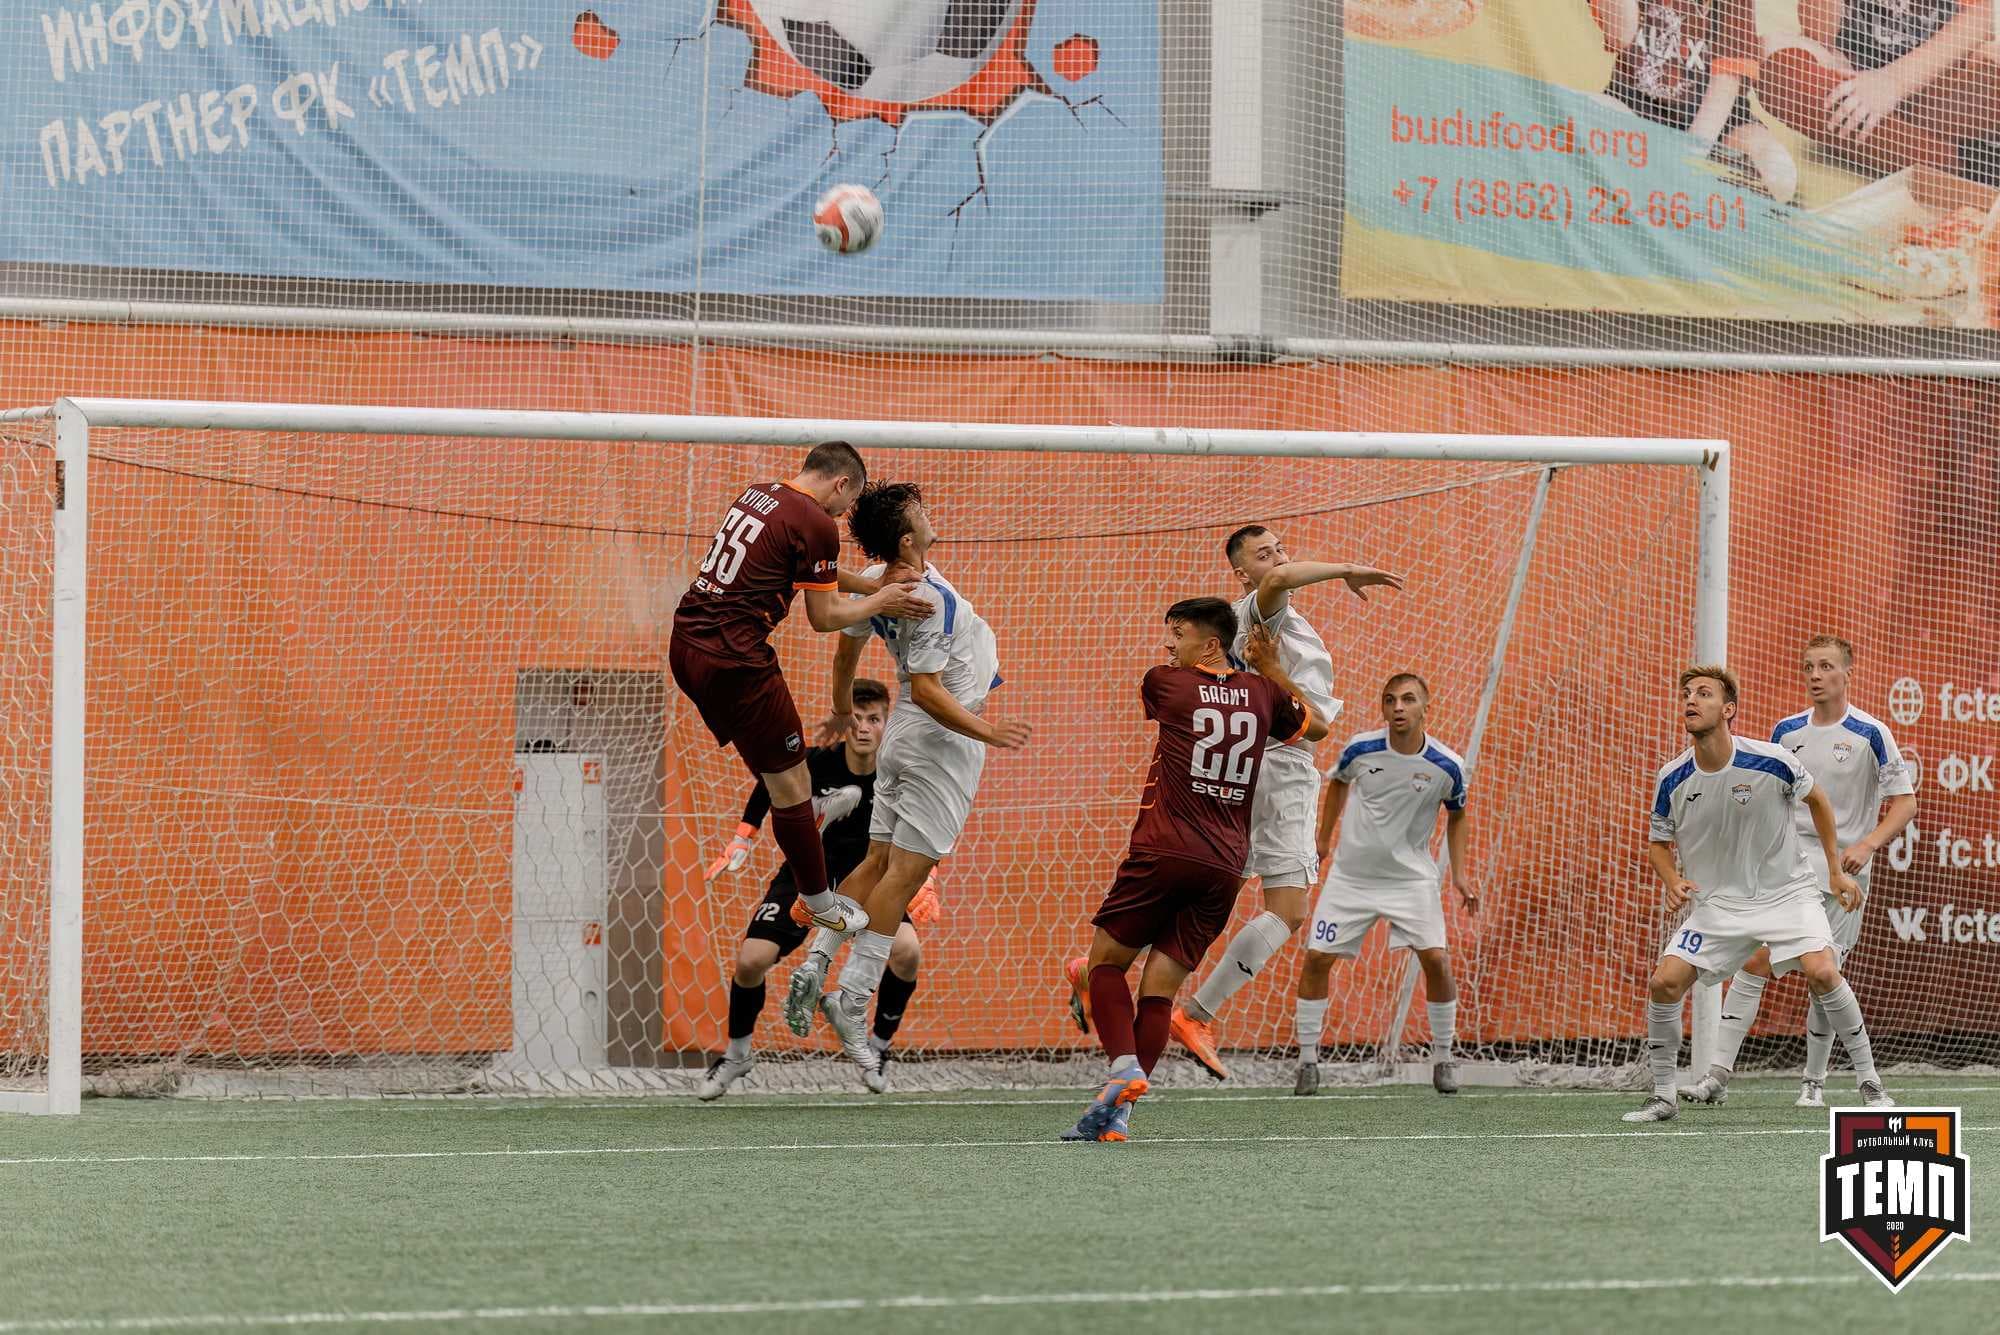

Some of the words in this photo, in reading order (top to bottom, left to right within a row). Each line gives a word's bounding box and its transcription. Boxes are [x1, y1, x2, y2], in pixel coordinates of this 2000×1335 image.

[38, 83, 258, 188] ПАРТНЕР
[271, 60, 356, 136] ФК
[367, 27, 544, 114] «ТЕМП»
[1391, 104, 1649, 168] budufood.org
[1392, 176, 1440, 214] +7
[1453, 177, 1573, 231] (3852)
[1585, 184, 1745, 231] 22-66-01
[1198, 684, 1250, 707] БАБИЧ
[1190, 707, 1259, 785] 22
[1191, 781, 1246, 802] SEUS
[1938, 752, 1995, 793] ФК
[1936, 828, 2000, 868] fc.t
[1315, 920, 1338, 943] 96
[1677, 930, 1703, 954] 19
